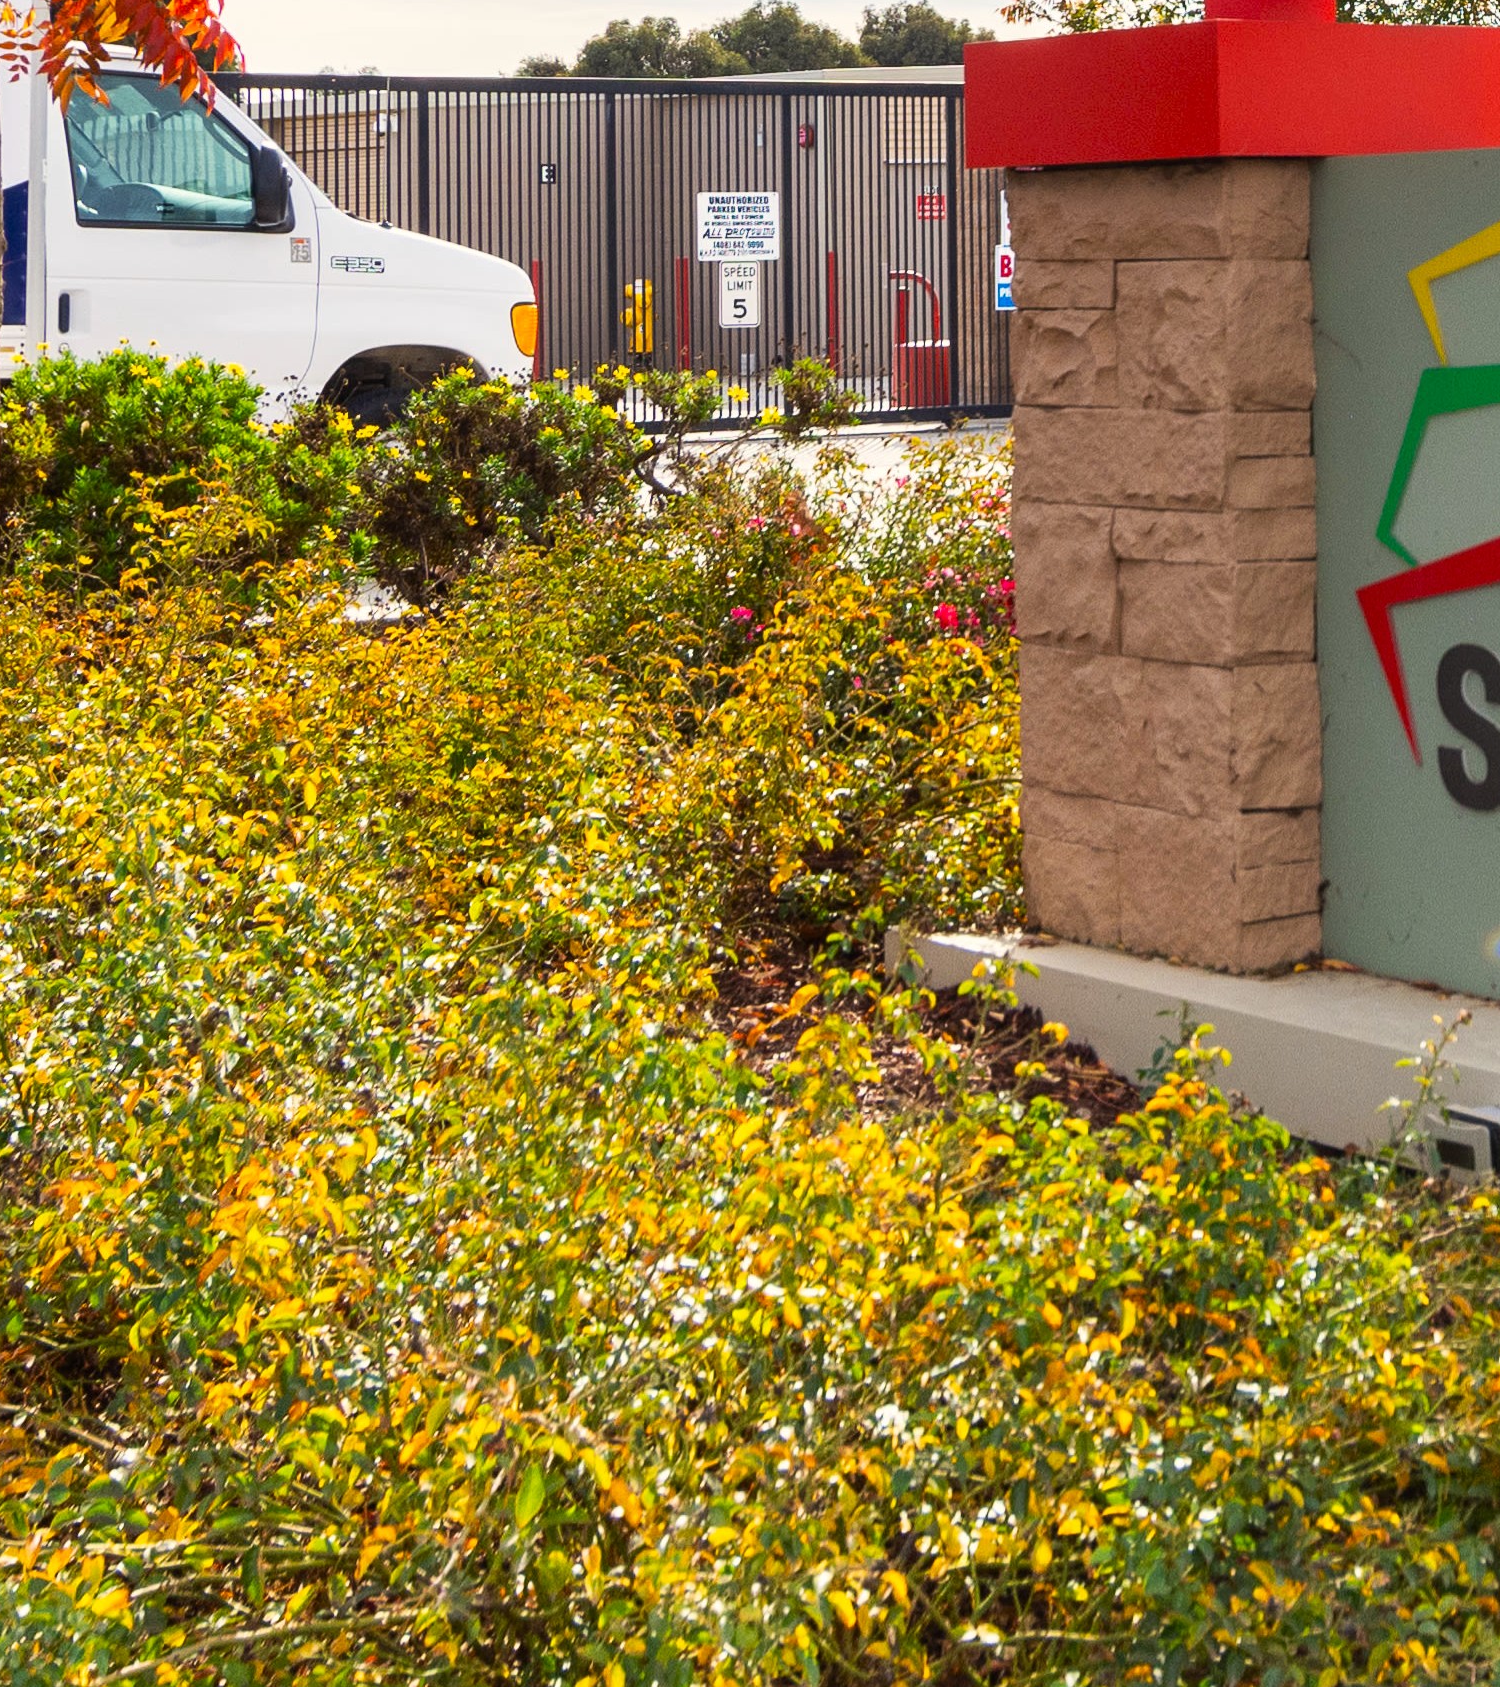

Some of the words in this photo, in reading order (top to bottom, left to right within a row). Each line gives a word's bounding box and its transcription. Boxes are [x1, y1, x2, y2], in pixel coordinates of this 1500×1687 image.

[708, 196, 769, 205] UNAUTHORIZED
[707, 205, 736, 213] PARKED
[737, 205, 770, 213] VEHICLES
[703, 227, 722, 239] ALL
[724, 266, 756, 278] SPEED
[727, 280, 753, 291] LIMIT
[733, 298, 747, 318] 5
